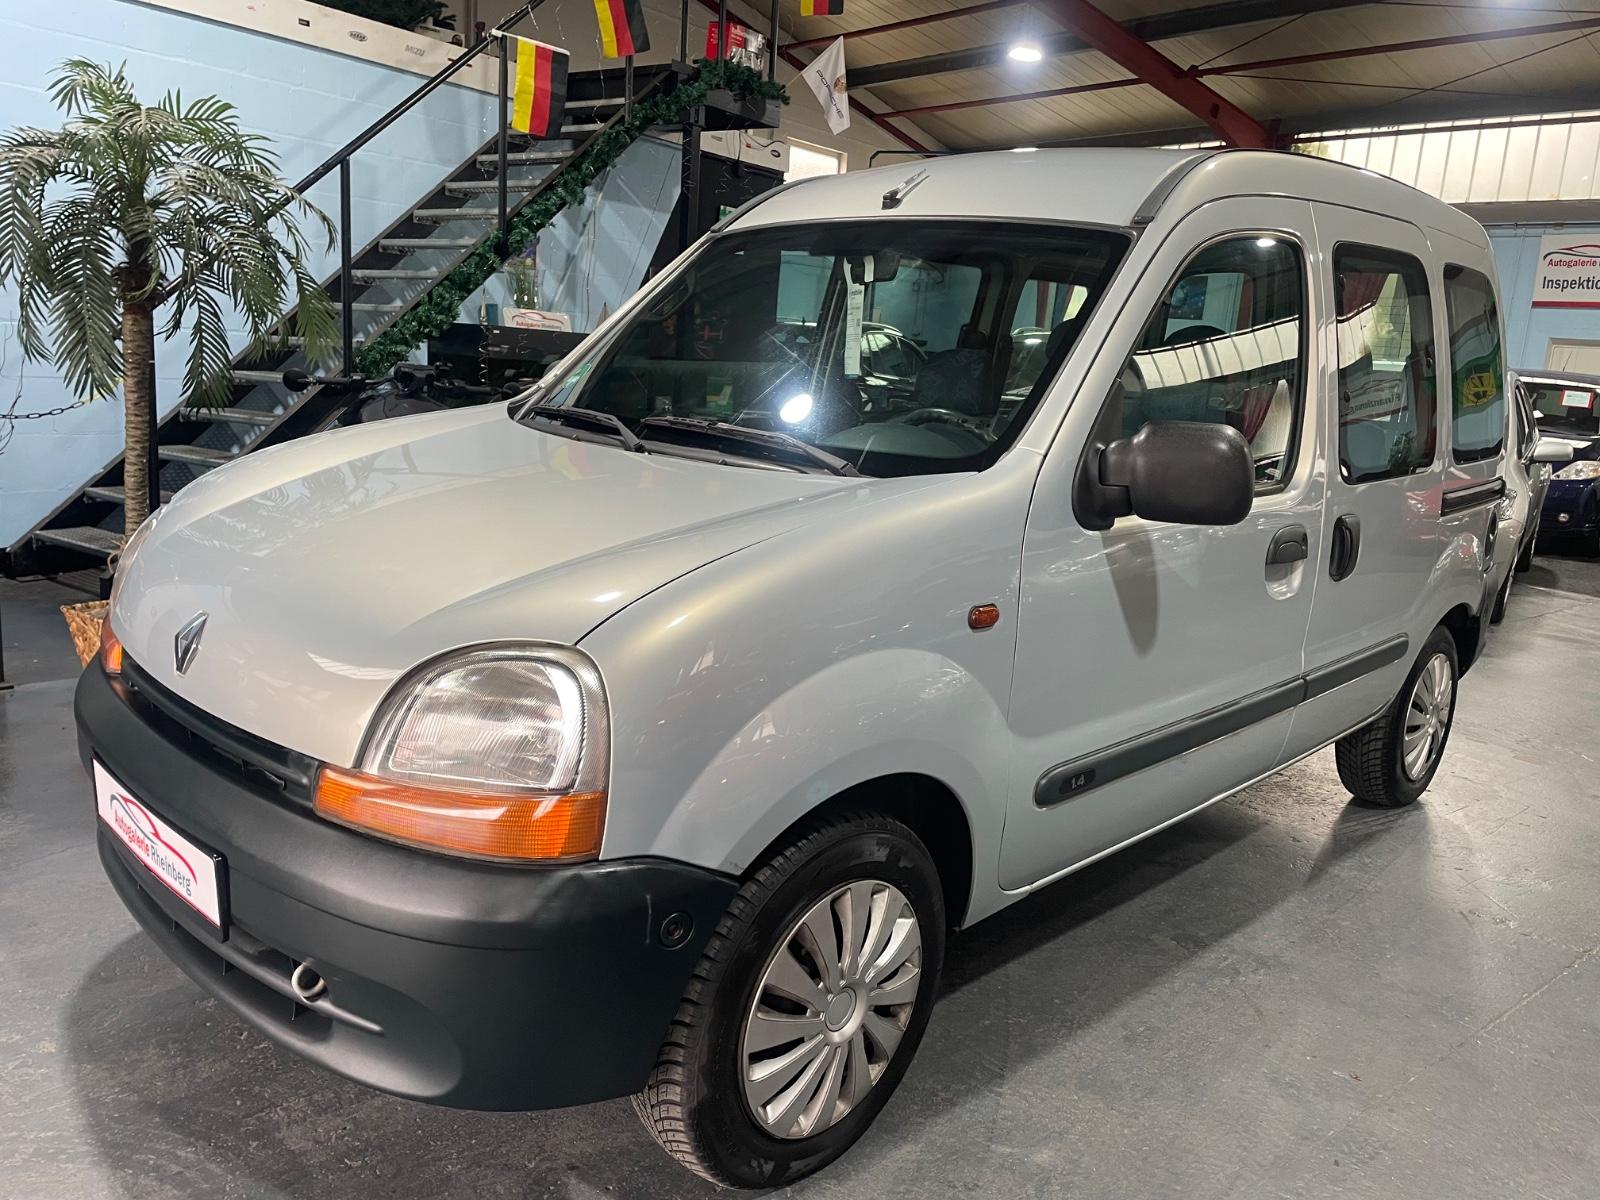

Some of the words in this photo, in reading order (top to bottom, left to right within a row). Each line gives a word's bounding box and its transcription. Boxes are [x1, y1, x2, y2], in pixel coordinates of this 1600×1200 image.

[1548, 258, 1597, 268] Autogalerie
[114, 808, 150, 857] Autogalerie
[150, 844, 192, 897] Rheinberg
